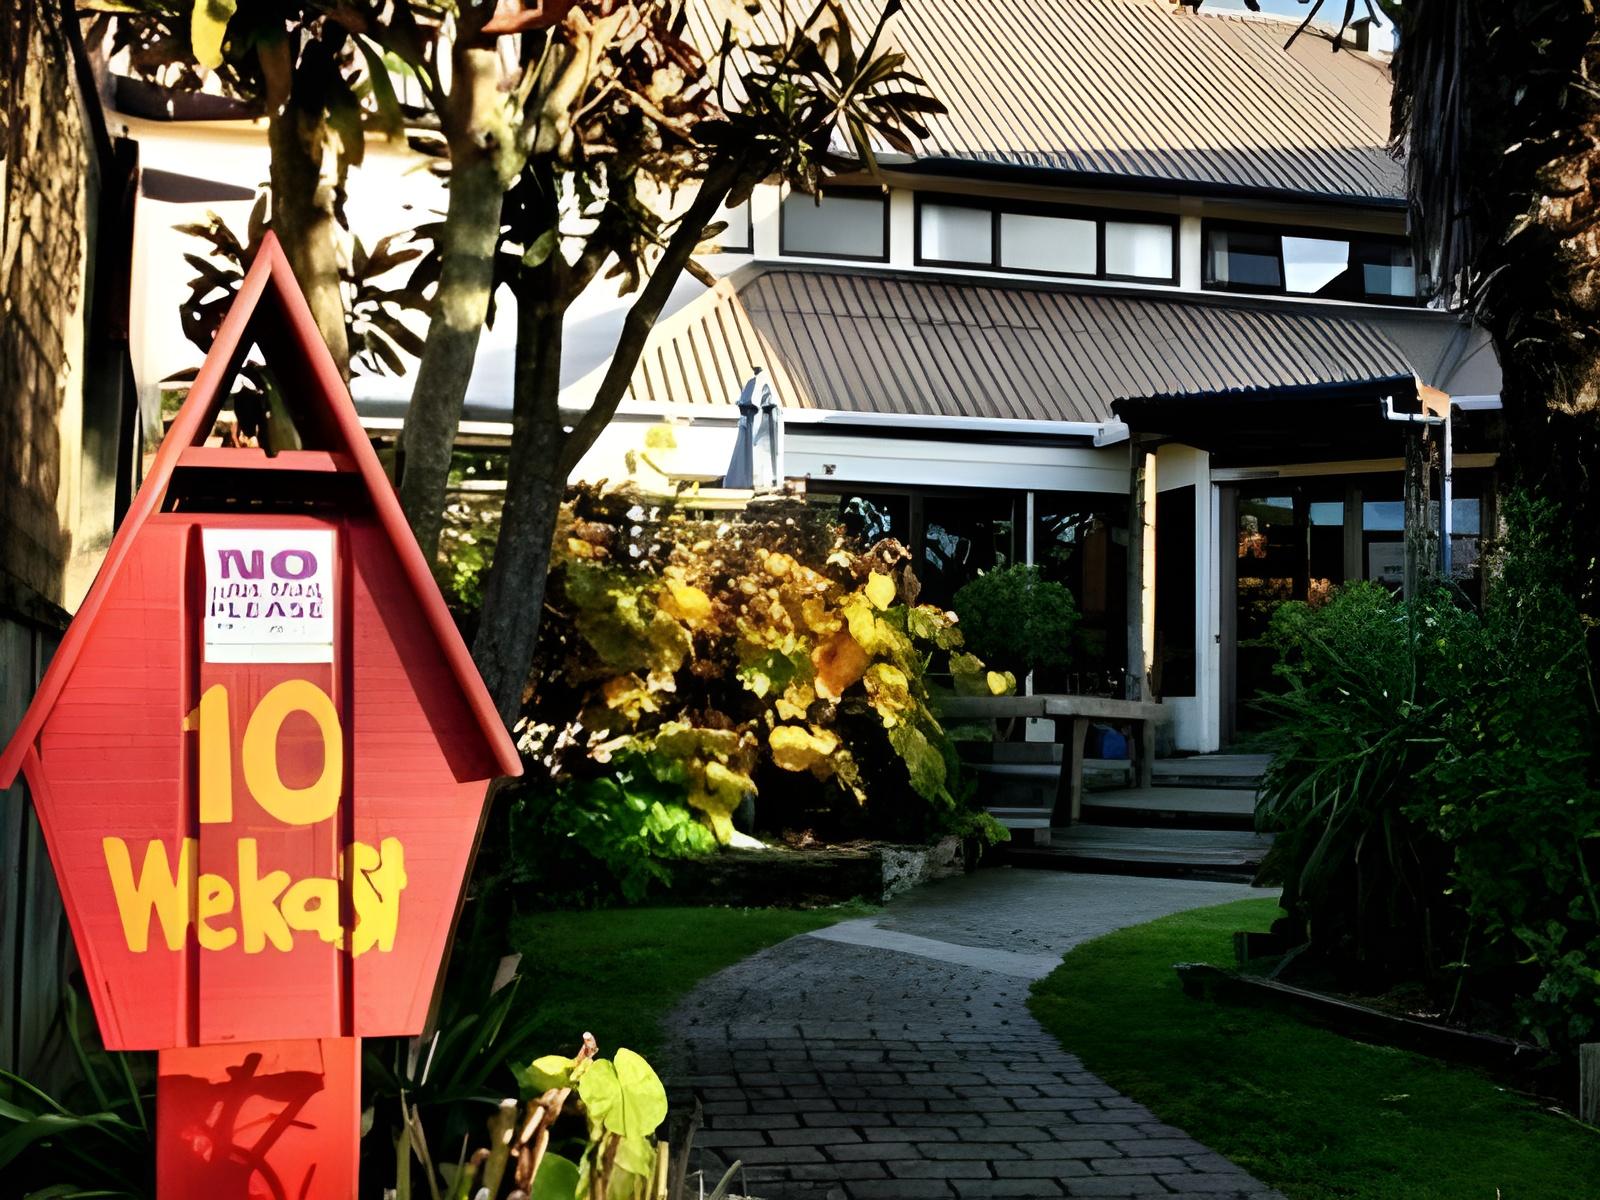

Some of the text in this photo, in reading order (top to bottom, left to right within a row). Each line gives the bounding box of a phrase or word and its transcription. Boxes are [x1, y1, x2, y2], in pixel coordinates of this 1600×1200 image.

[217, 549, 318, 580] NO
[182, 679, 343, 825] 10
[102, 837, 339, 954] Weka
